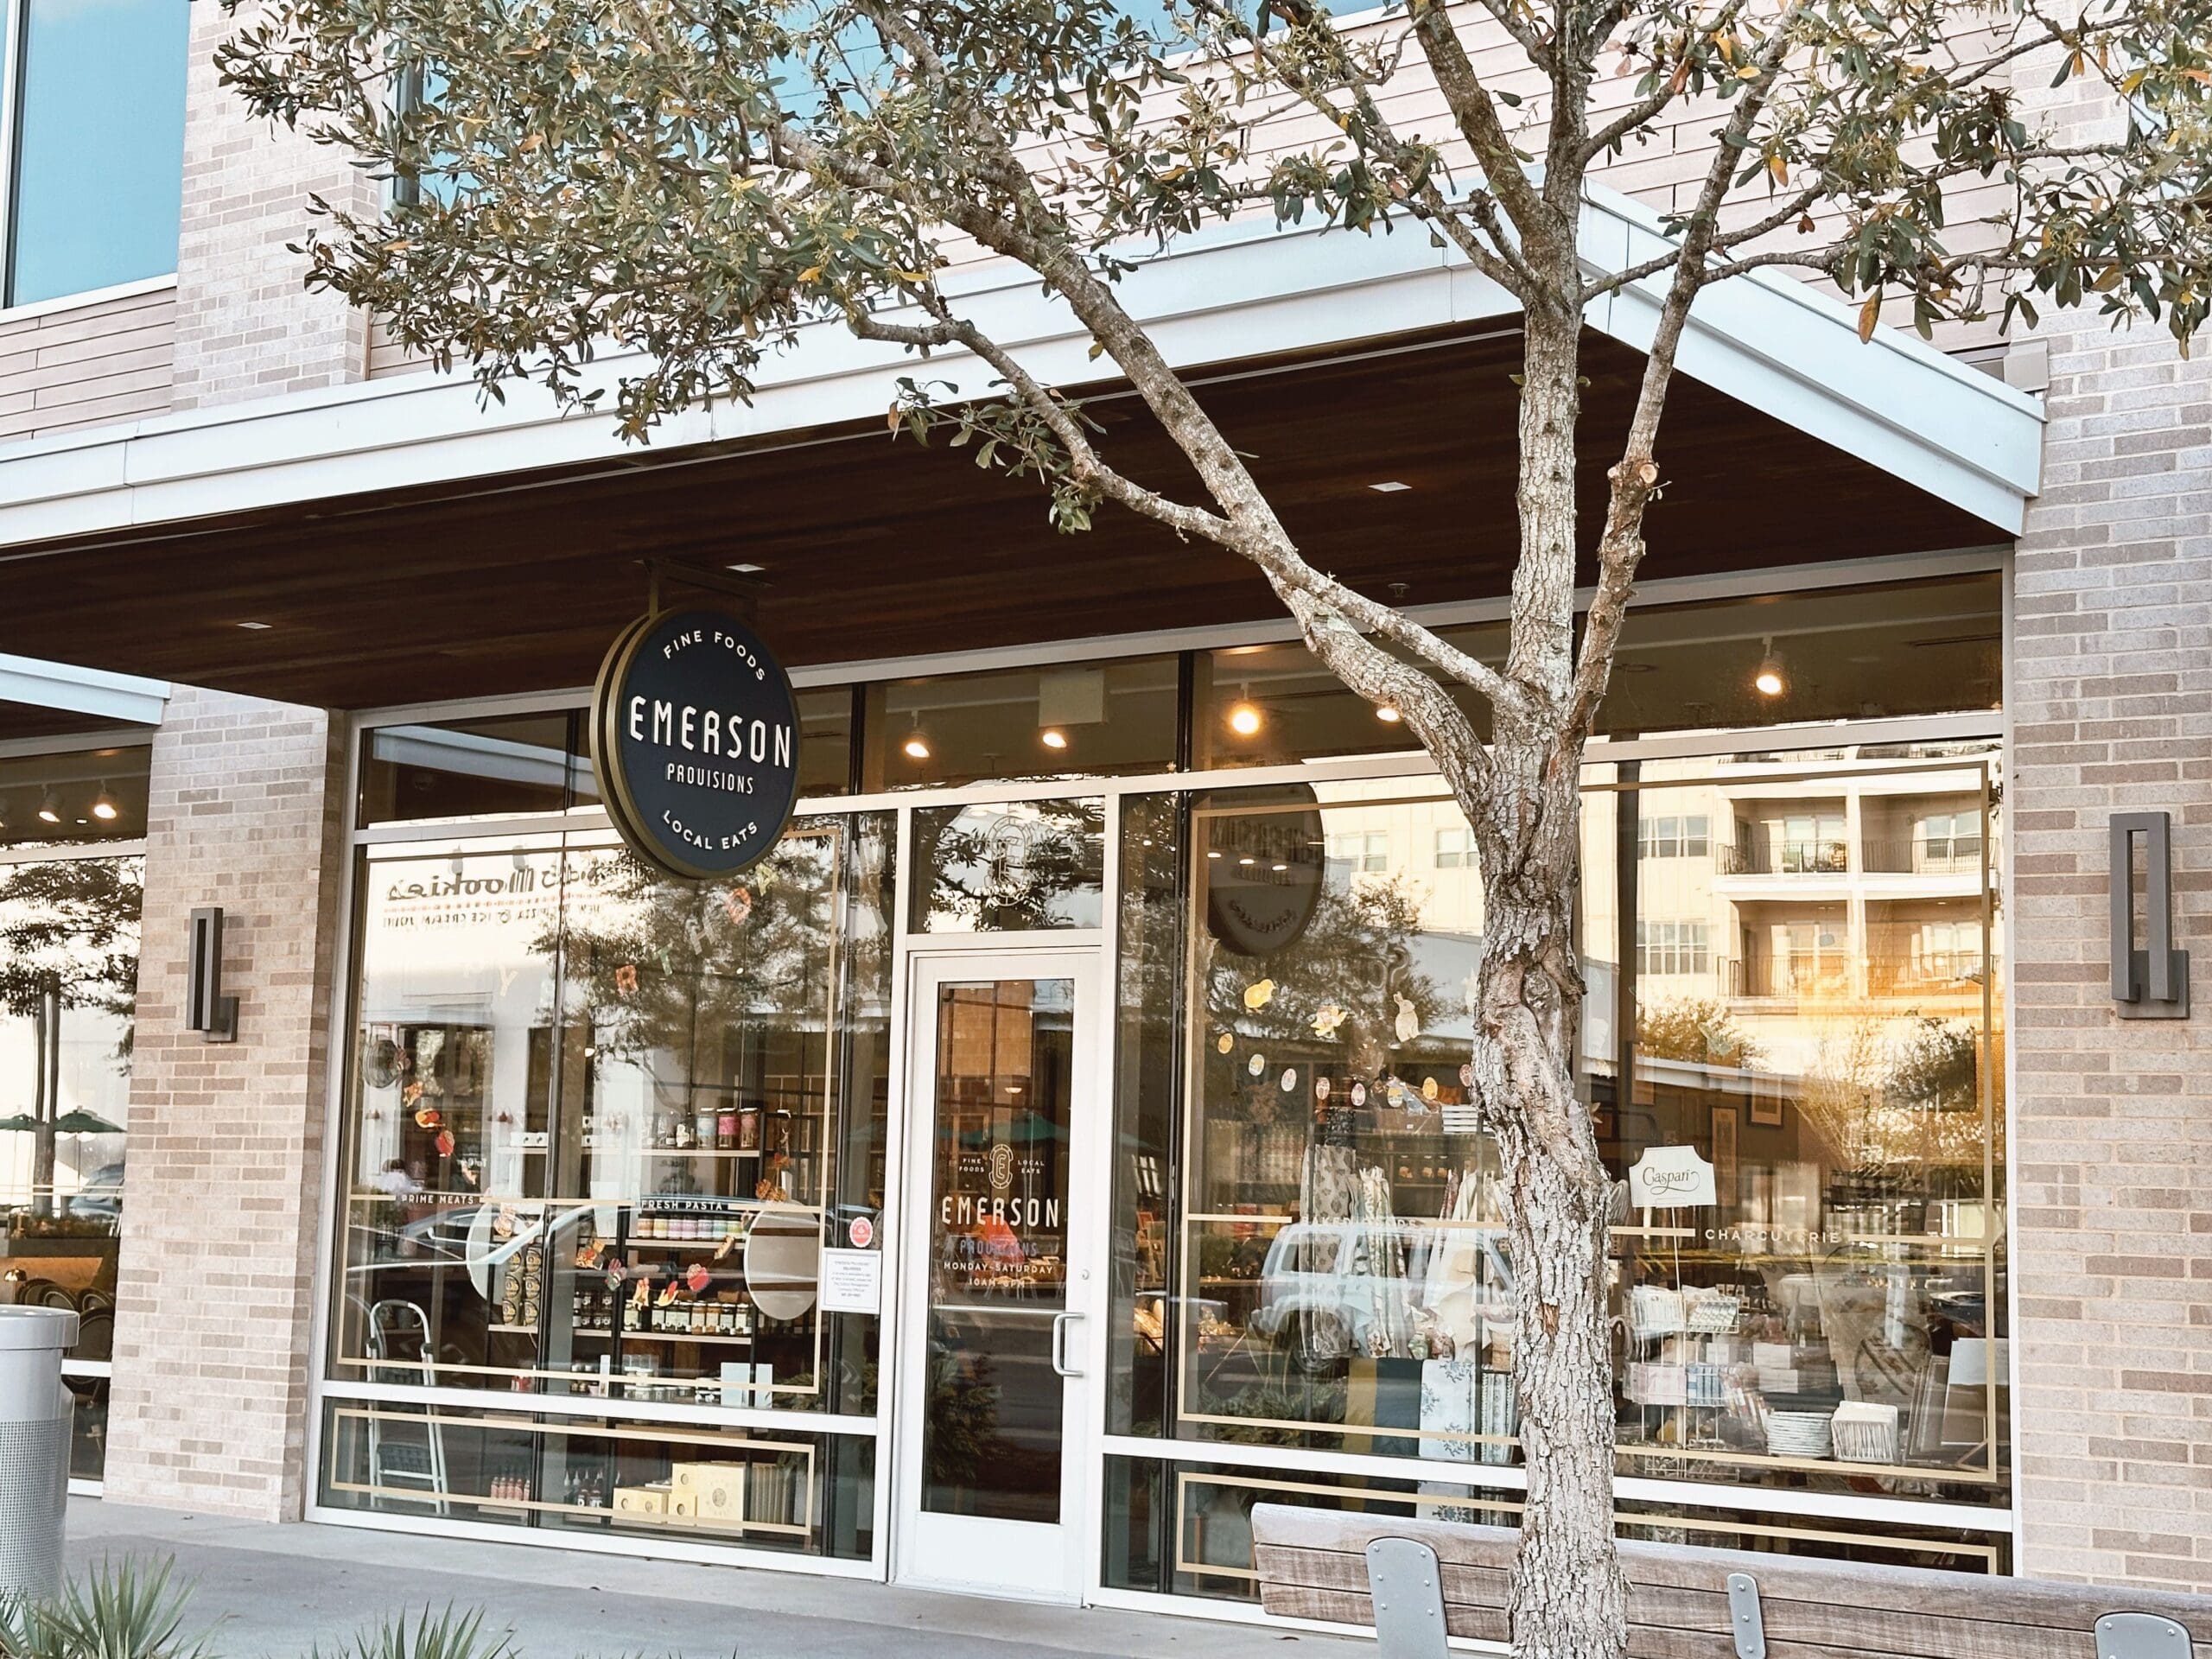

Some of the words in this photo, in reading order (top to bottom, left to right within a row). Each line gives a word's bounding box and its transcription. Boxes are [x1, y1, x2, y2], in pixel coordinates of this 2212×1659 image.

[663, 630, 702, 659] FINE
[714, 631, 766, 682] FOODS
[628, 695, 791, 768] EMERSON
[663, 809, 713, 850] LOCAL
[721, 821, 758, 850] EATS
[401, 1194, 434, 1204] PRIME
[439, 1195, 474, 1205] MEATS
[641, 1199, 678, 1209] FRESH
[685, 1201, 722, 1211] PASTA
[942, 1196, 1058, 1227] EMERSON
[1705, 1229, 1840, 1243] CHARCUTERIE
